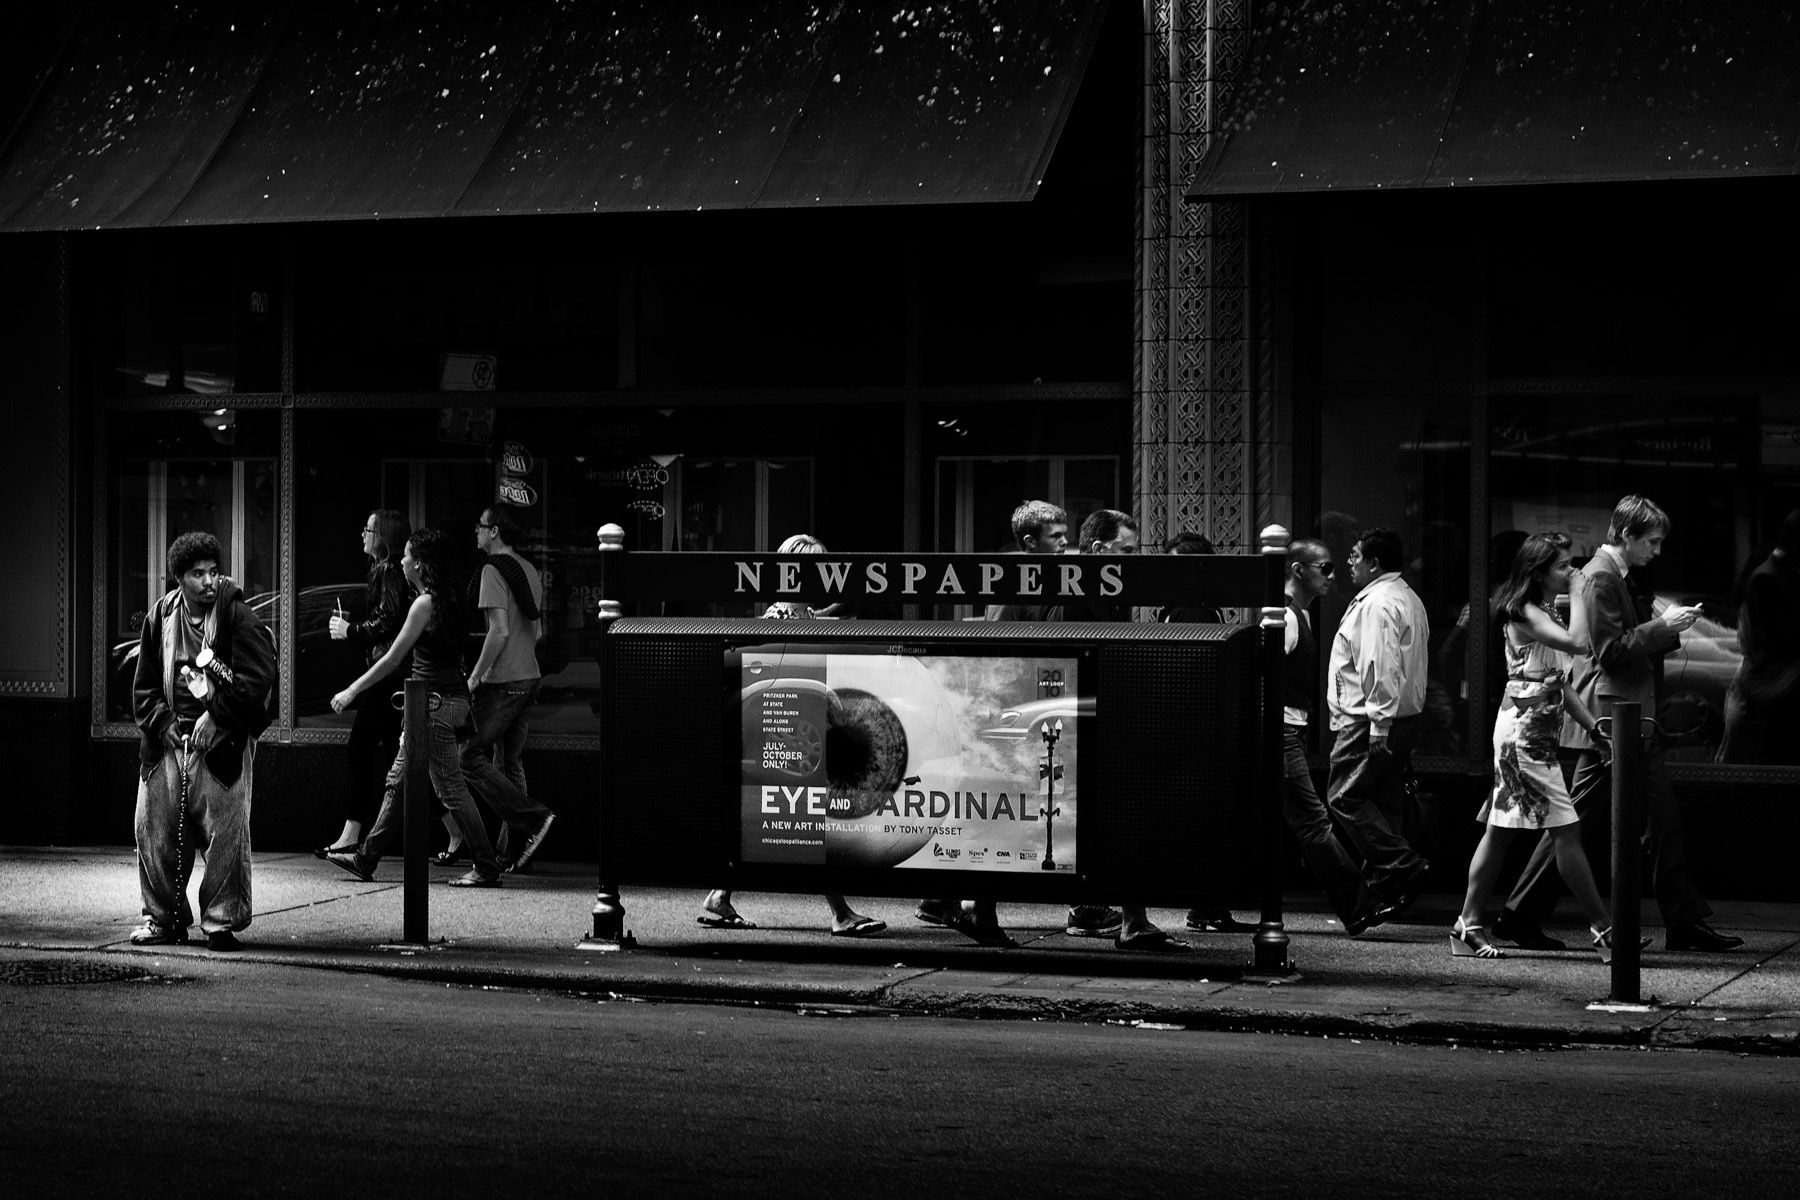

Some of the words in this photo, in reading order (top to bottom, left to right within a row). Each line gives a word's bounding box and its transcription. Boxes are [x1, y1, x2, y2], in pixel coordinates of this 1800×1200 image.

[734, 561, 1124, 596] NEWSPAPERS
[887, 645, 927, 654] JCDecaux
[1042, 669, 1062, 682] 20
[1046, 686, 1060, 697] 10
[763, 751, 803, 760] OCTOBER
[763, 760, 788, 769] ONLY!
[761, 785, 827, 815] EYE
[829, 798, 851, 811] AND
[762, 821, 769, 829] A
[771, 821, 792, 830] NEW
[794, 821, 813, 831] ART
[815, 822, 881, 833] INSTALLATION
[884, 825, 896, 833] BY
[899, 825, 925, 834] TONY
[927, 826, 963, 836] TASSET
